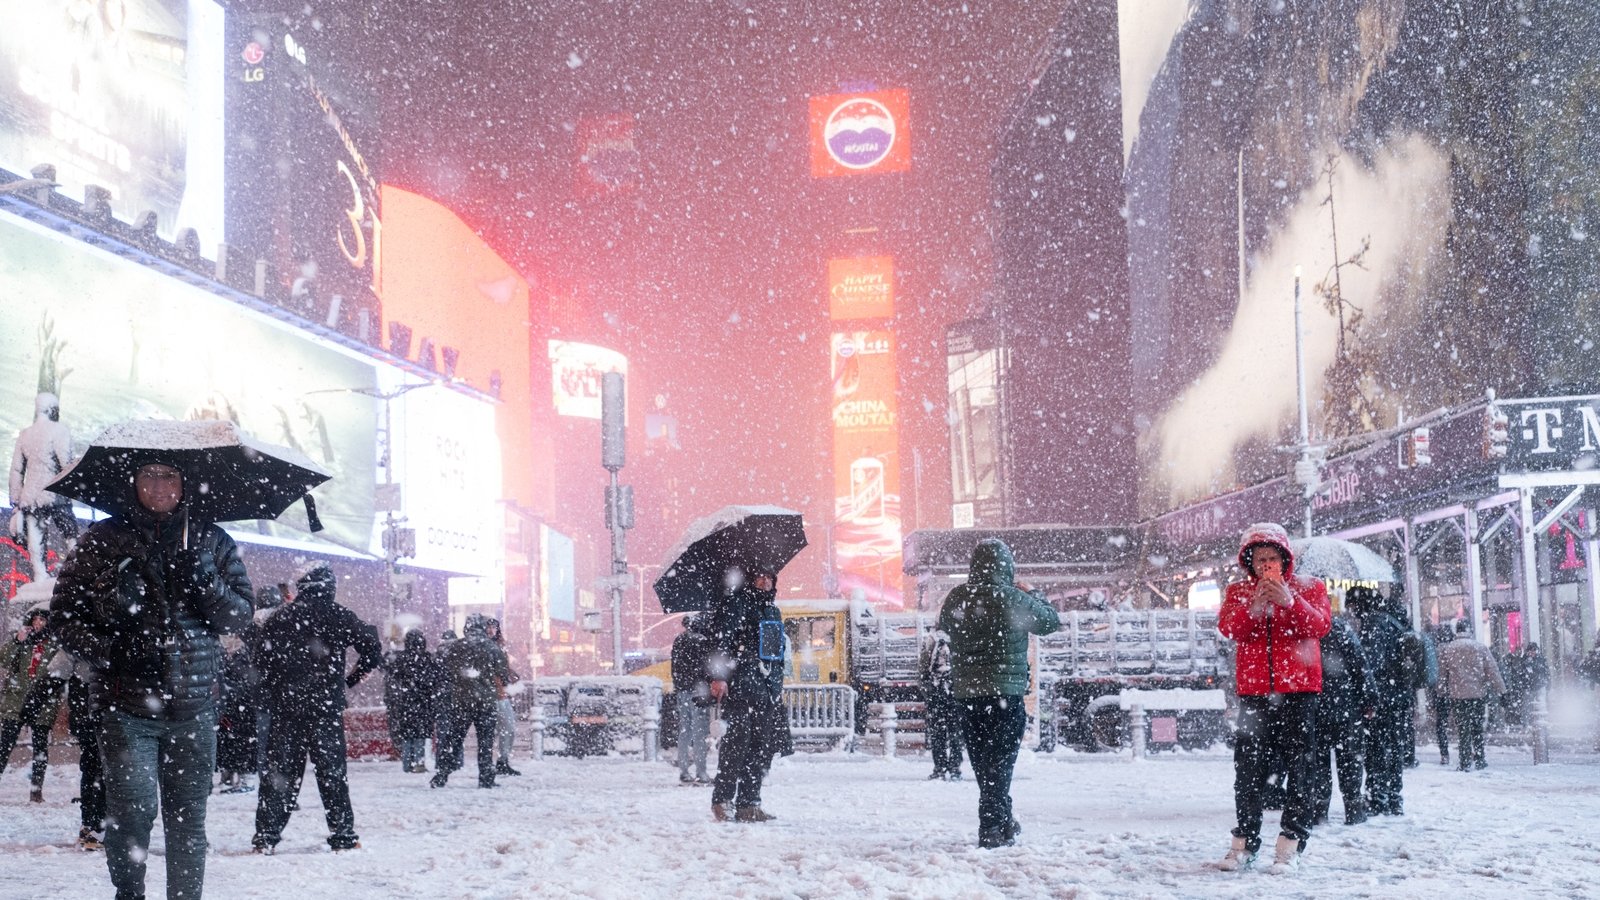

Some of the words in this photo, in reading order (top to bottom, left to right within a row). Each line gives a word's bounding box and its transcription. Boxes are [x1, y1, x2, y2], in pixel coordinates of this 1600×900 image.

[294, 42, 306, 64] LG
[244, 68, 265, 82] LG
[844, 142, 879, 154] MOUTAI
[844, 272, 884, 285] HAPPY
[838, 400, 888, 413] CHINA
[836, 412, 895, 427] MOUTAI
[1164, 507, 1220, 542] SEPHORA
